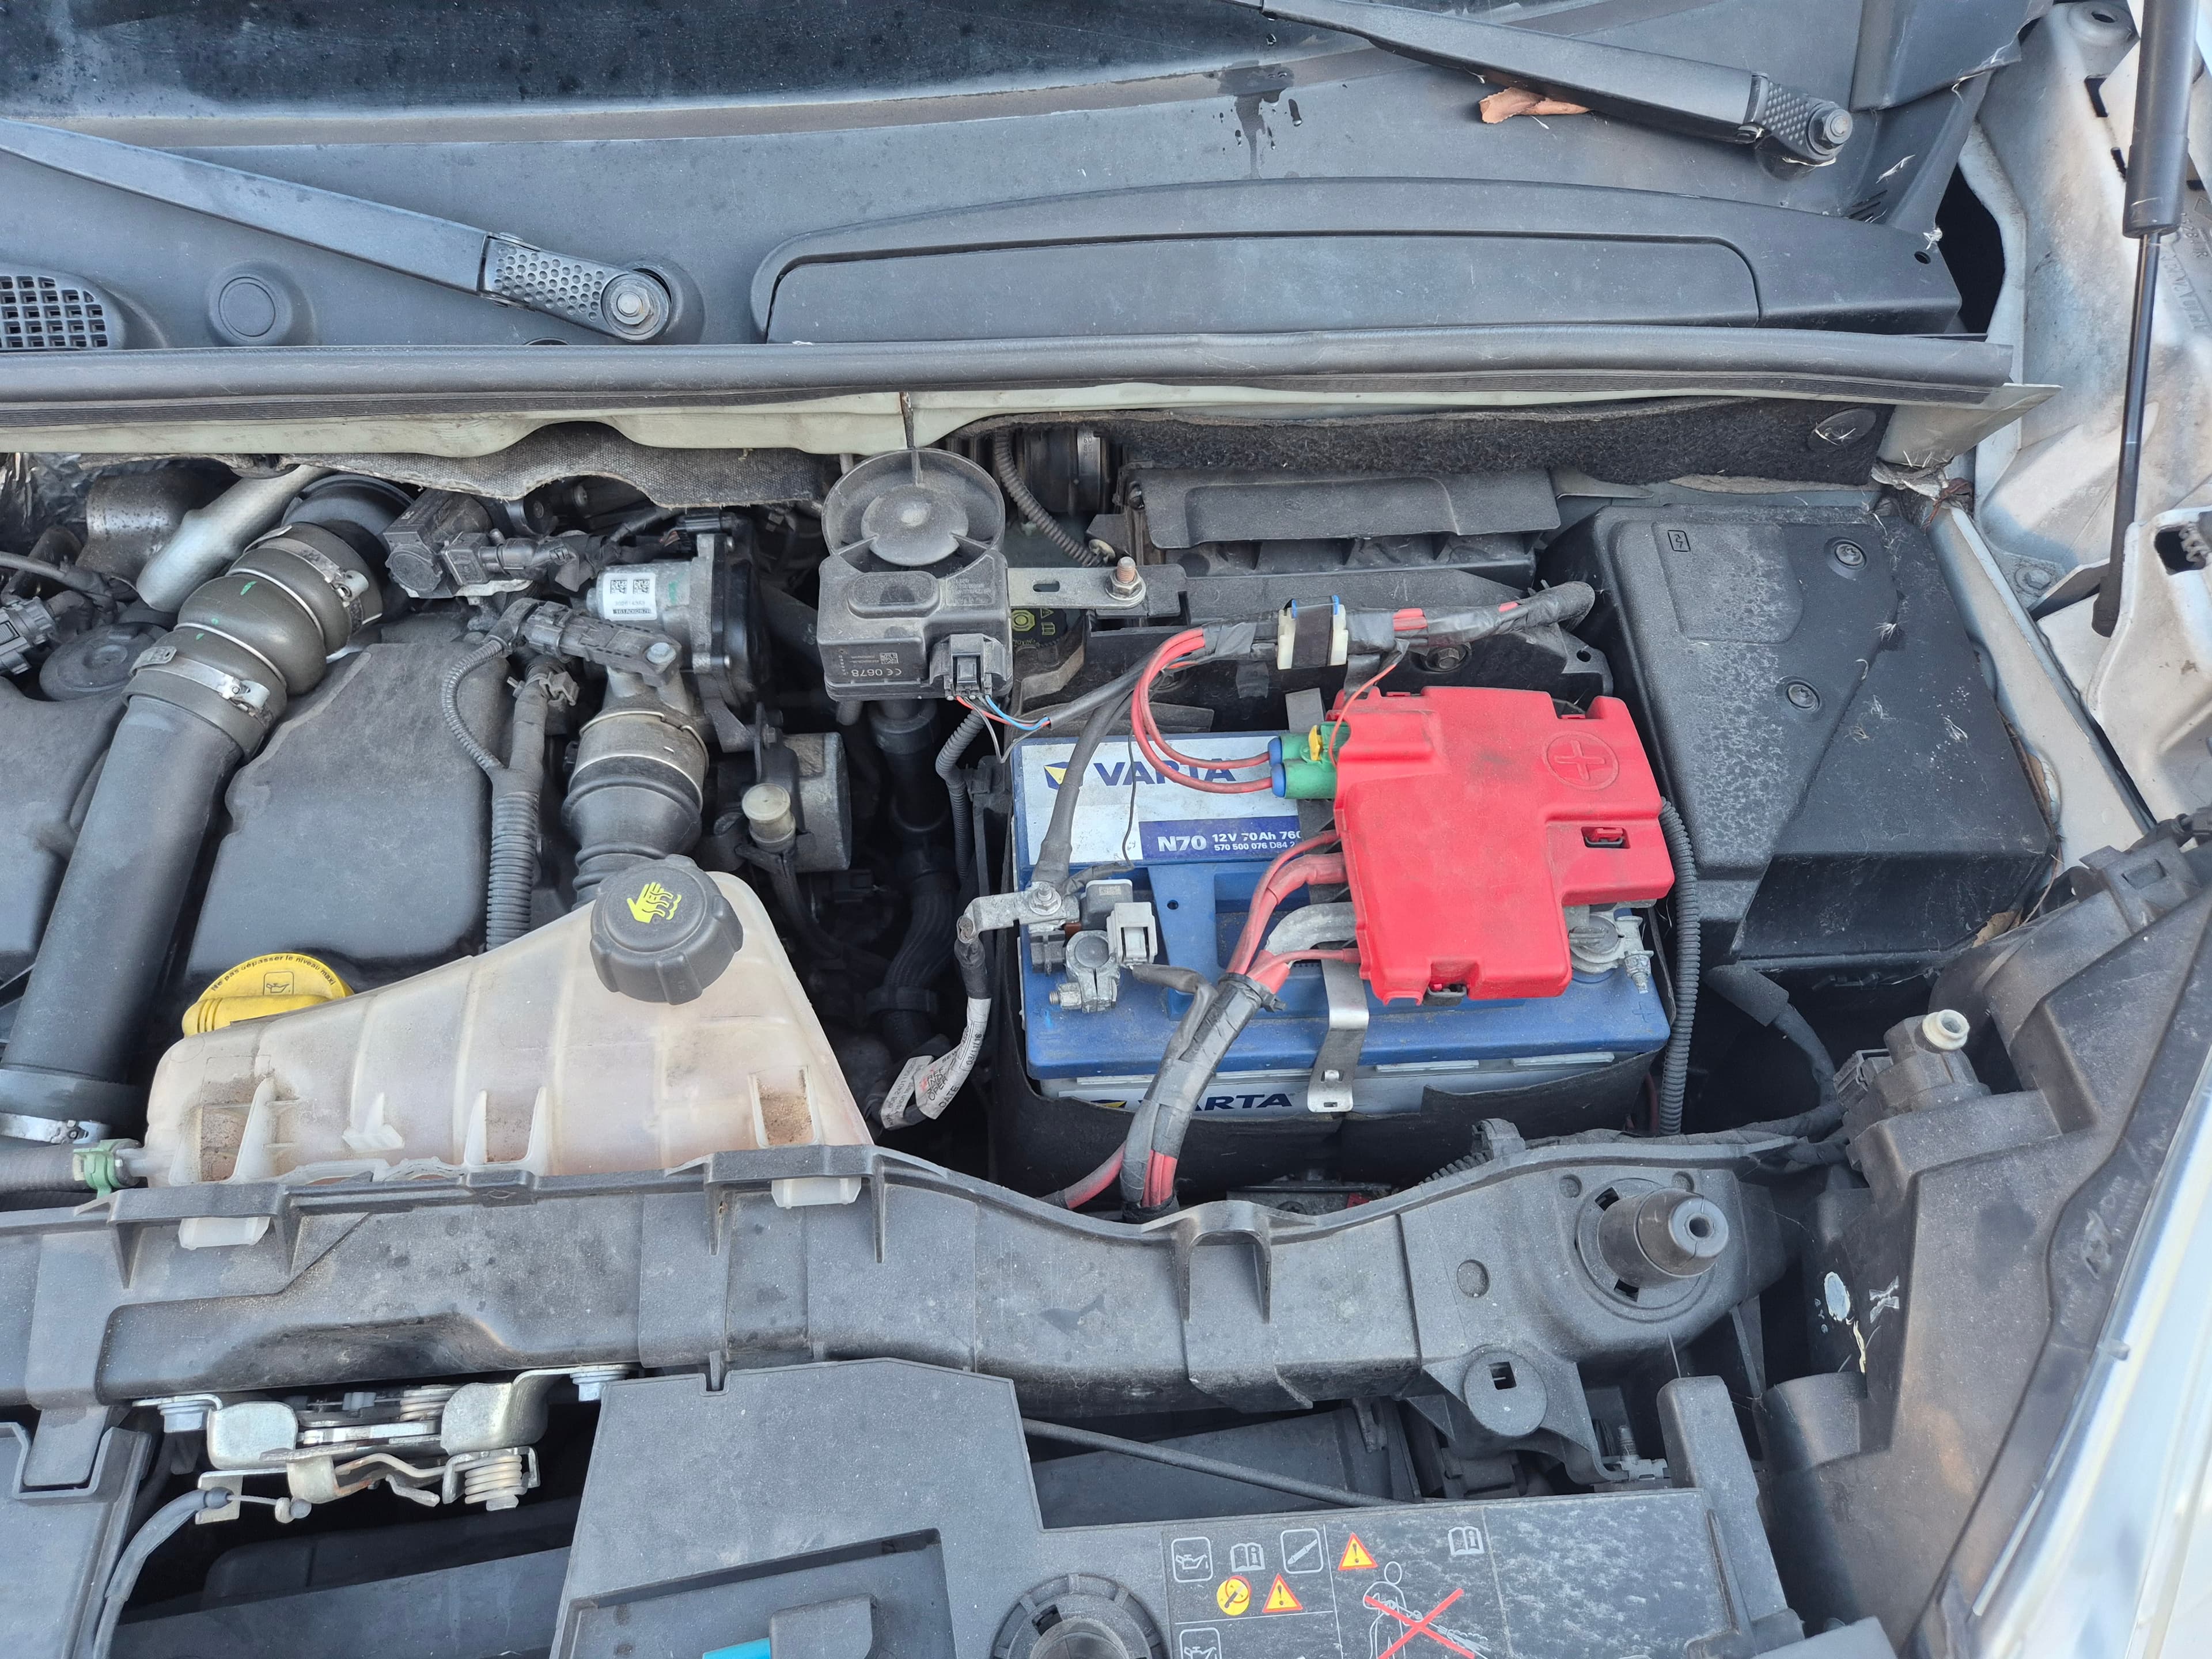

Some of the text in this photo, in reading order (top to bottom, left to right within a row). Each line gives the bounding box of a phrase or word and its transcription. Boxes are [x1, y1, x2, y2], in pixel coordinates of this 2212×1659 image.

[851, 669, 883, 677] 0678
[1157, 835, 1207, 852] N70
[1212, 833, 1237, 842] 12V
[211, 980, 223, 991] Ne
[224, 968, 240, 982] pas
[296, 957, 321, 970] niveau
[320, 969, 336, 986] maxi
[927, 1066, 944, 1081] REF
[938, 1085, 959, 1108] DATE
